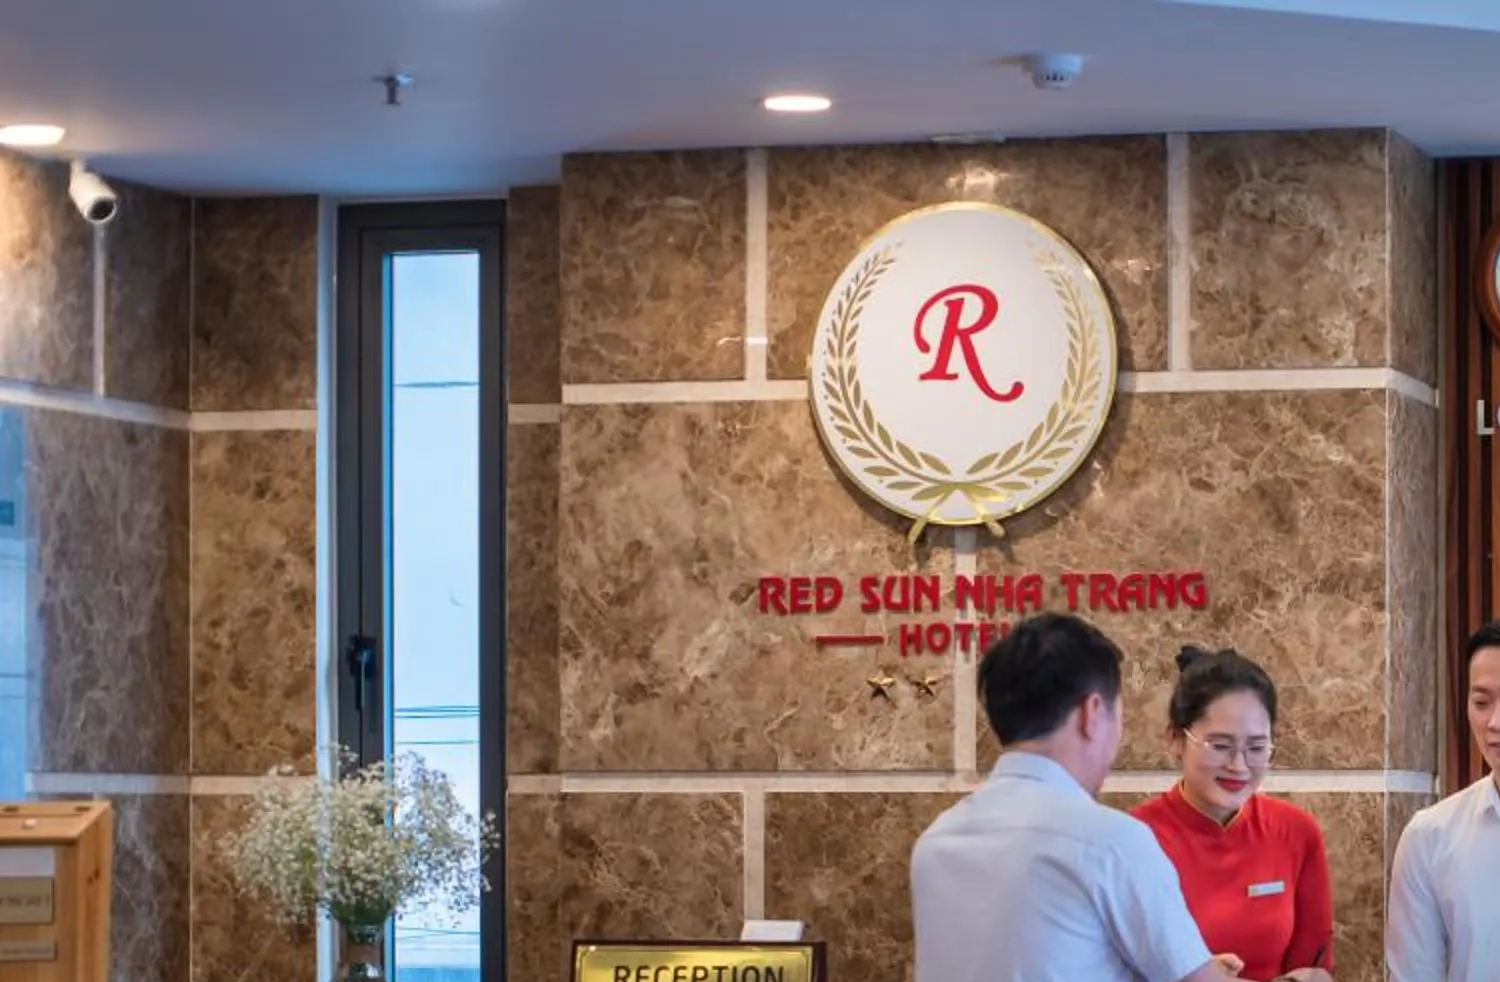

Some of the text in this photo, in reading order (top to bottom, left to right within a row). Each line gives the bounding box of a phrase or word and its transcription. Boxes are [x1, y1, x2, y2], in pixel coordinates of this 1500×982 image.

[914, 284, 1024, 402] R
[759, 572, 1206, 616] RED SUN NHA TRANG
[900, 623, 1010, 657] HOTE
